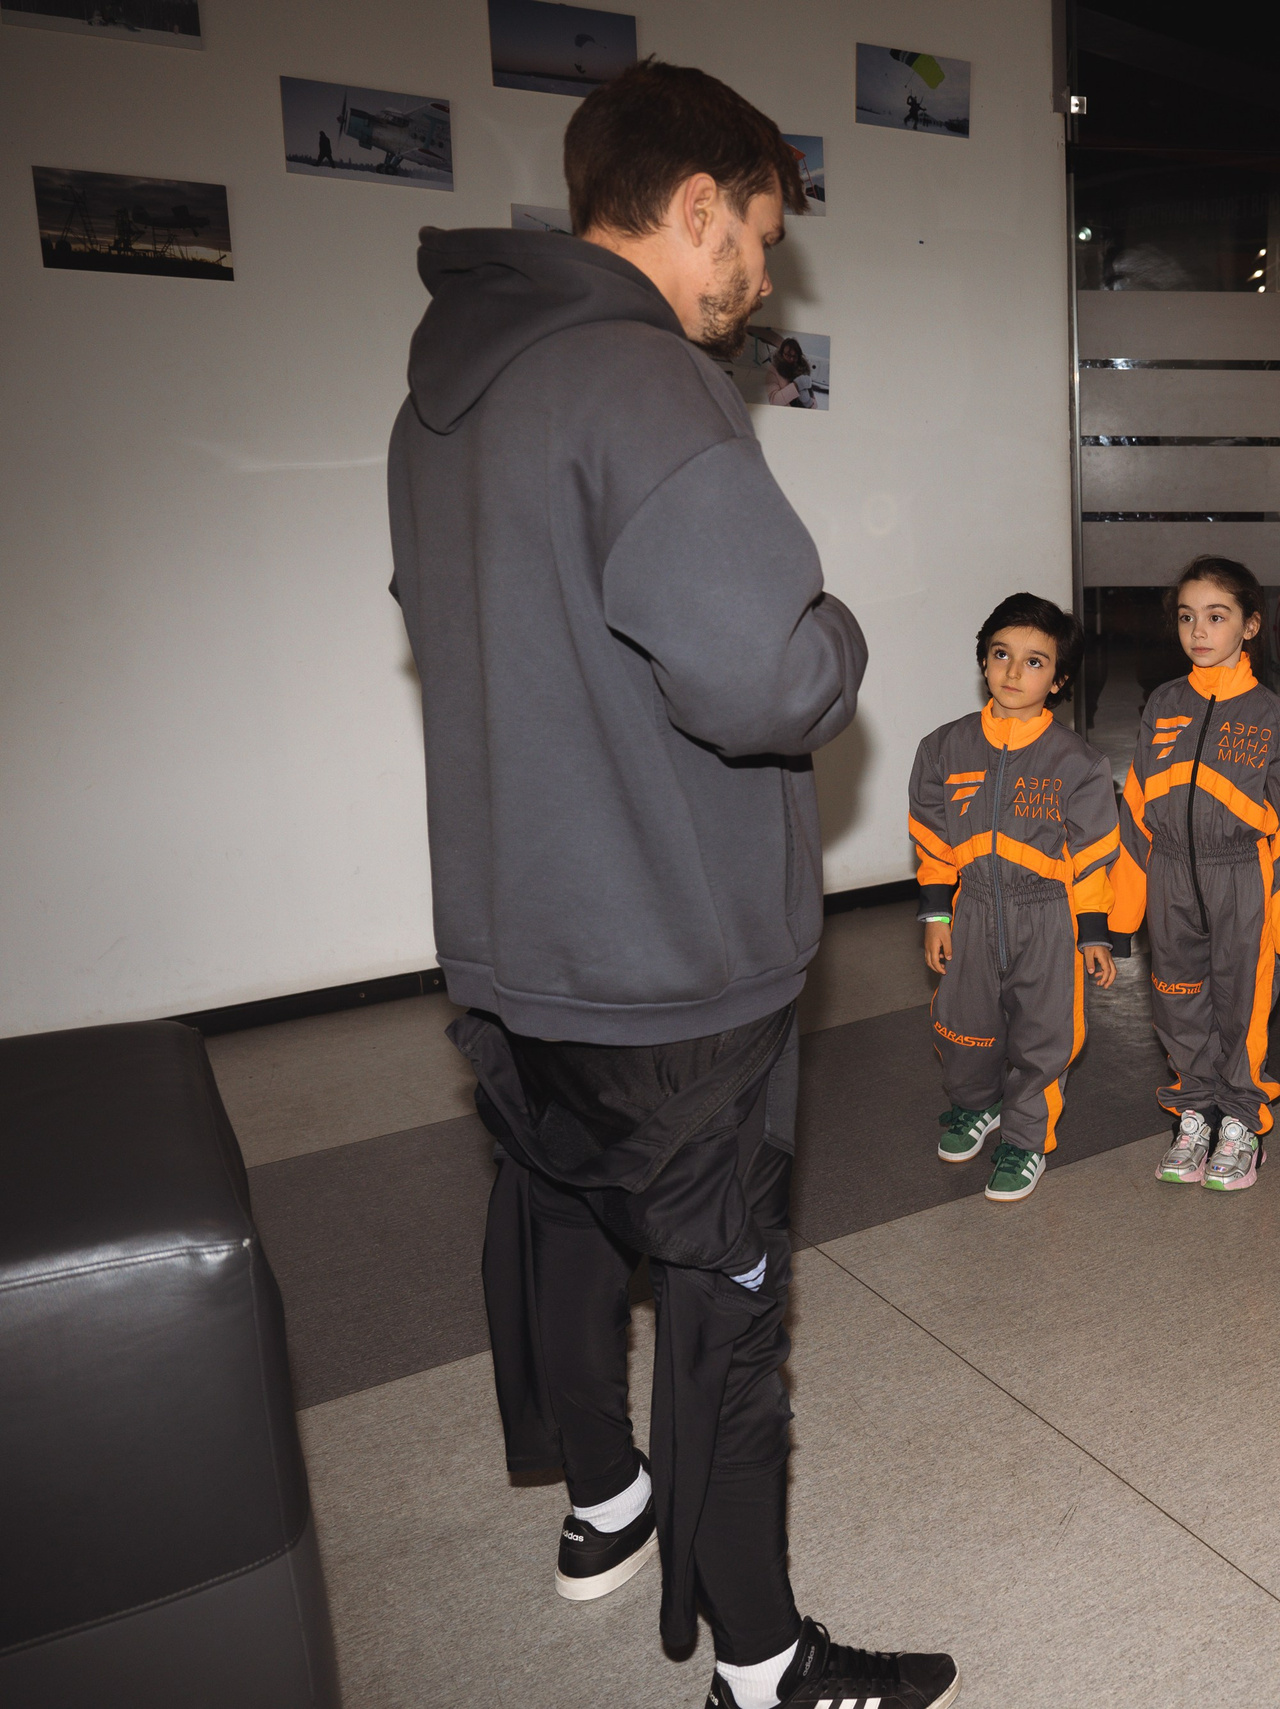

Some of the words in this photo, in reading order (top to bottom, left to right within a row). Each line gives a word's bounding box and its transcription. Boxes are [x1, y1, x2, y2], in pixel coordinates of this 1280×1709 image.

[1219, 721, 1272, 742] АЭРО
[1218, 735, 1268, 755] ДИНА
[1014, 776, 1063, 792] АЭРО
[802, 1645, 816, 1677] adidas
